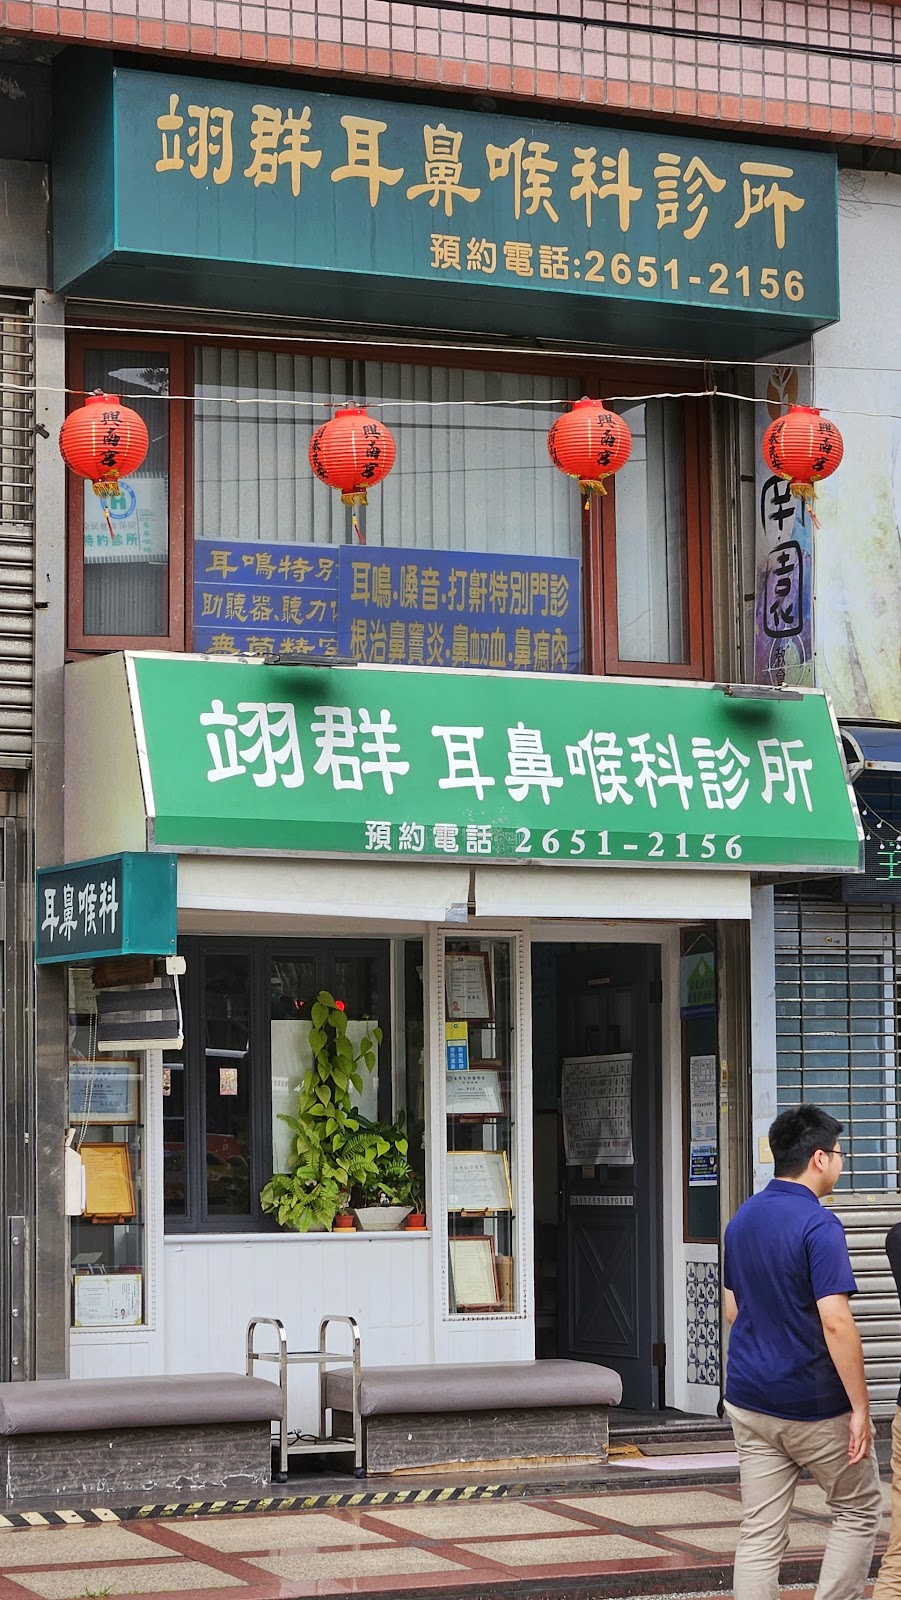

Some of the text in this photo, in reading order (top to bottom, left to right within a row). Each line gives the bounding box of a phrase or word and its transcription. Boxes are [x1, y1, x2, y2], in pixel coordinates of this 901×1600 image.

[155, 93, 805, 249] 翊群耳鼻喉科診所
[199, 698, 814, 812] 翊群 耳鼻喉科診所
[364, 821, 743, 860] 預約電話 2651-2156
[41, 876, 119, 943] 耳鼻喉科
